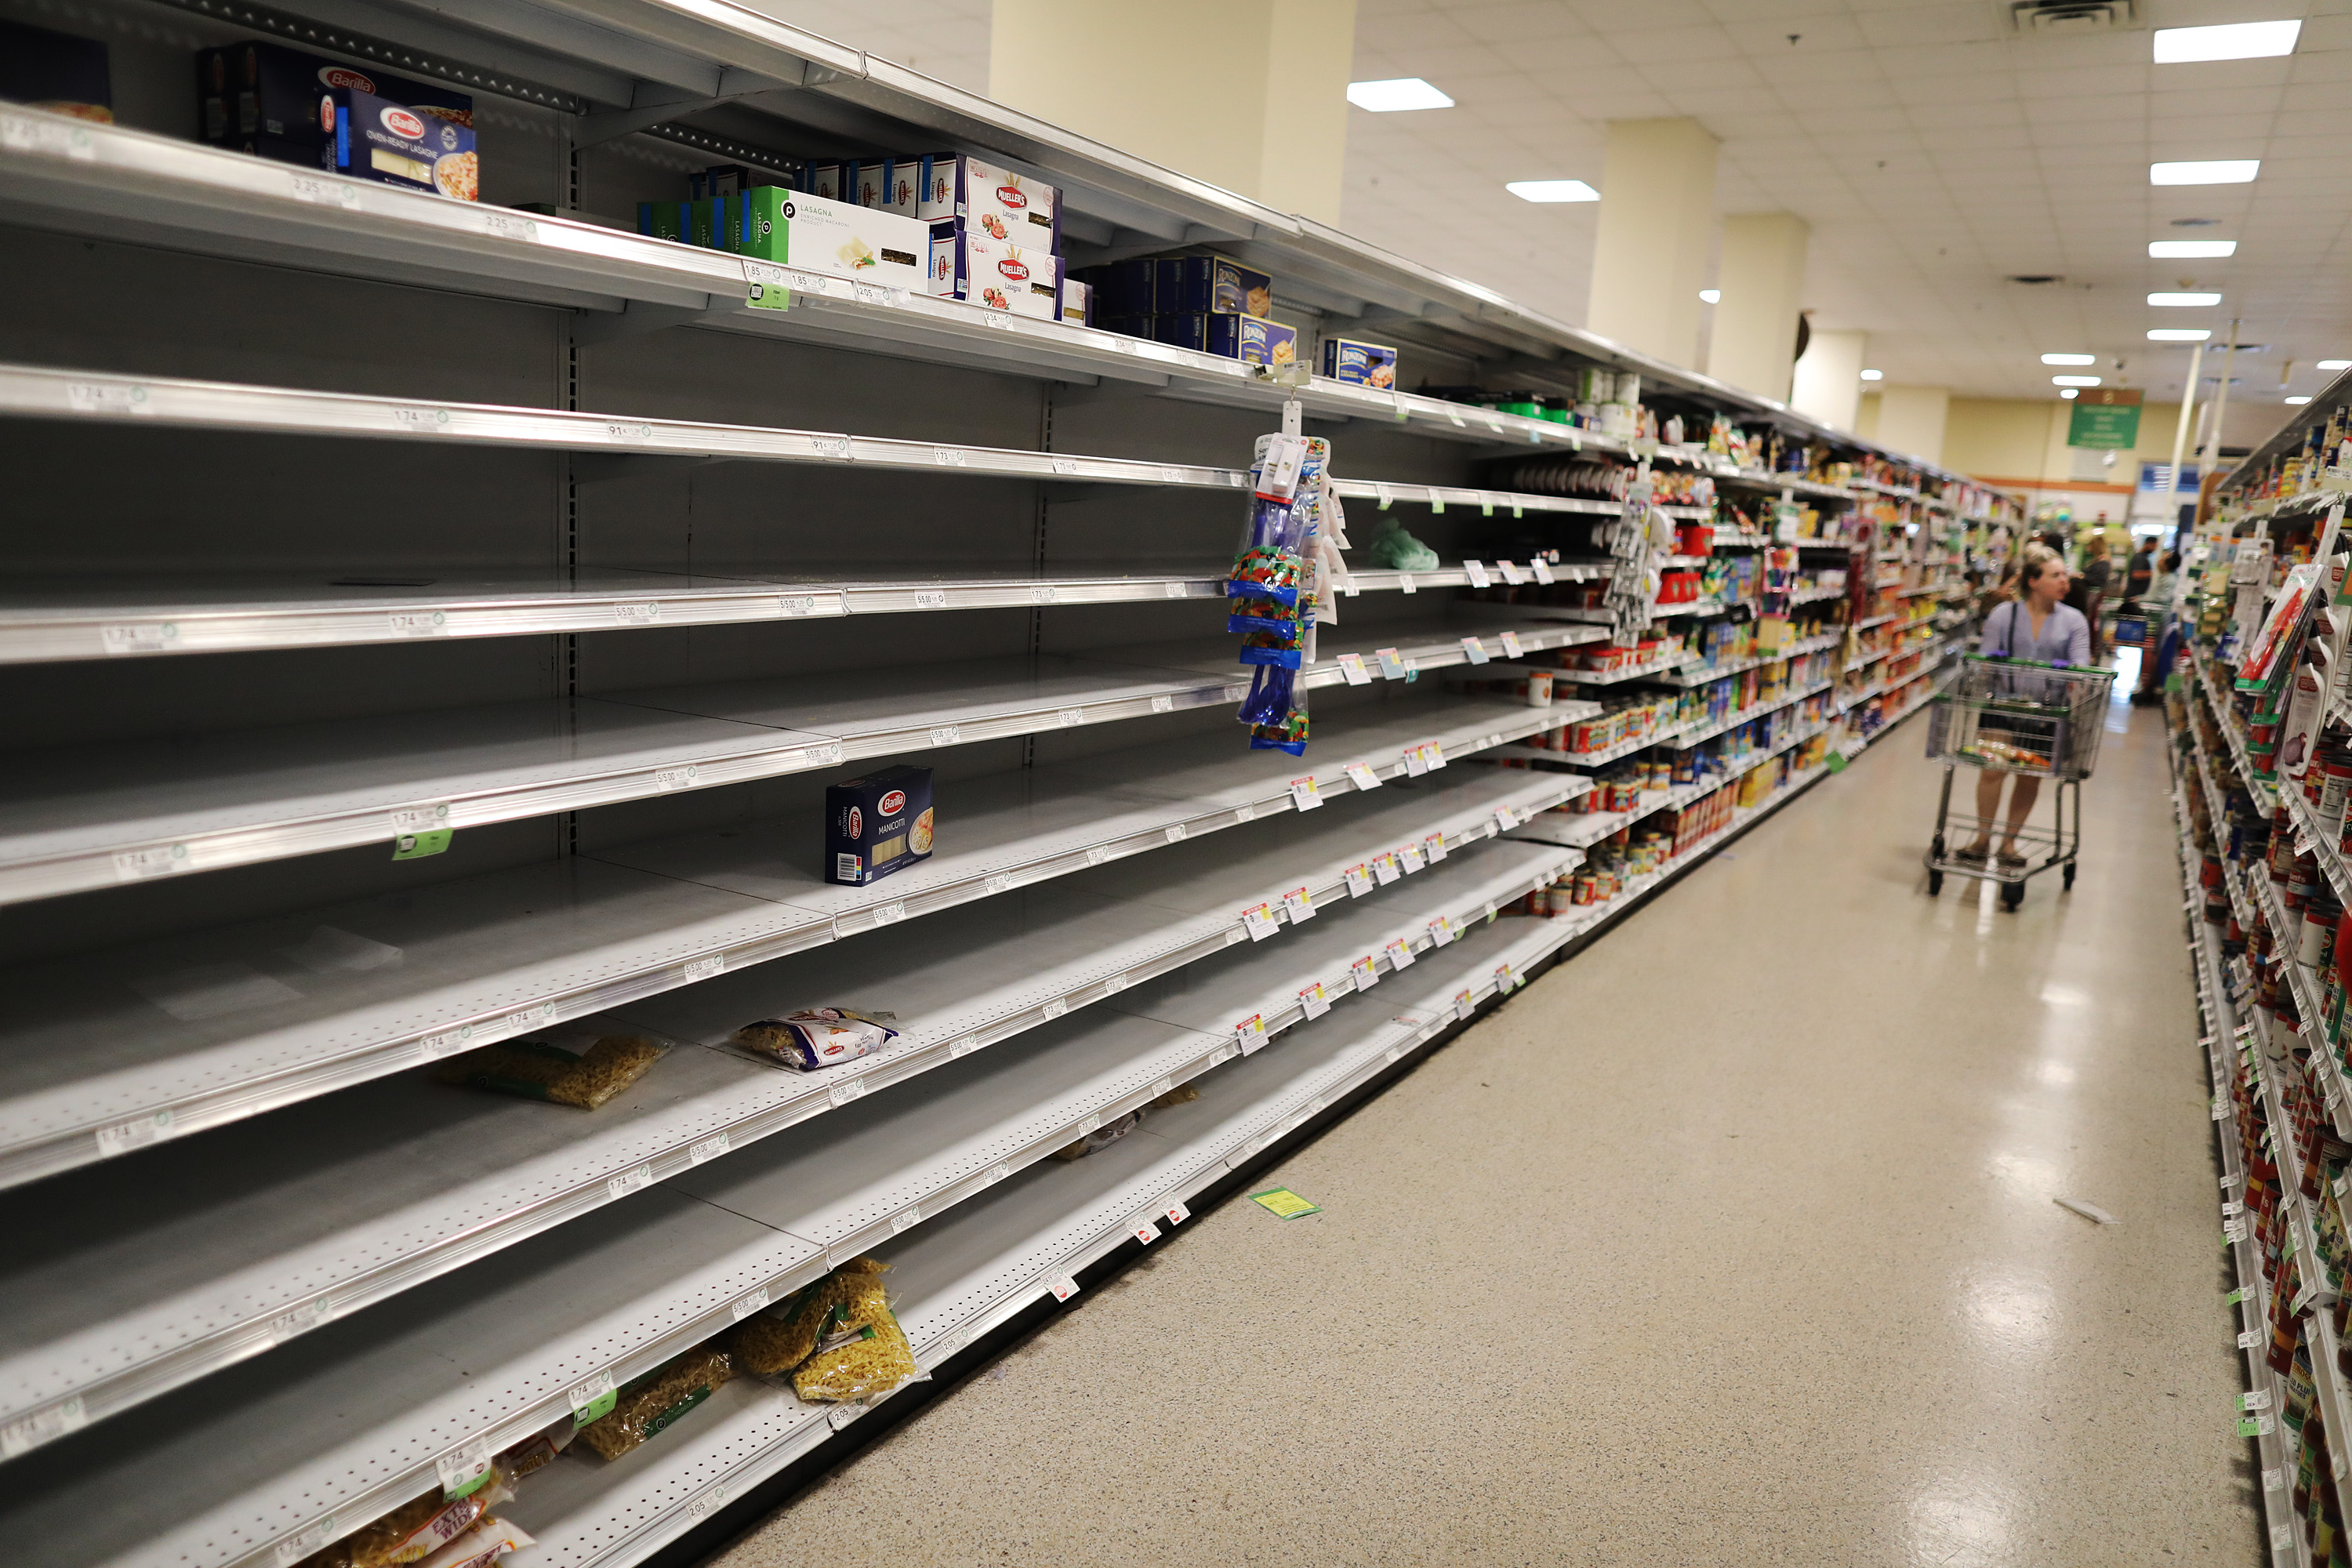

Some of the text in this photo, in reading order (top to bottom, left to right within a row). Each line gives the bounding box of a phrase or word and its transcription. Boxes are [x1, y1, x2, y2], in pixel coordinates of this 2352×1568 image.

[332, 73, 372, 92] Barilla
[391, 113, 422, 134] Barilla
[997, 188, 1026, 207] MUELLER'S
[800, 204, 833, 218] LASAGNA
[1002, 209, 1019, 221] Lasagna
[800, 213, 850, 229] ENRICHED MACARONI
[800, 218, 822, 227] PRODUCT
[745, 264, 760, 276] 1.85
[1000, 261, 1029, 278] MUELLER'S
[792, 274, 808, 285] 1.85
[1004, 281, 1022, 293] Lasagna
[1243, 324, 1267, 343] RONZONI
[1341, 350, 1367, 365] RONZONI
[884, 793, 903, 811] Barilla
[878, 817, 906, 836] MANICOTTI
